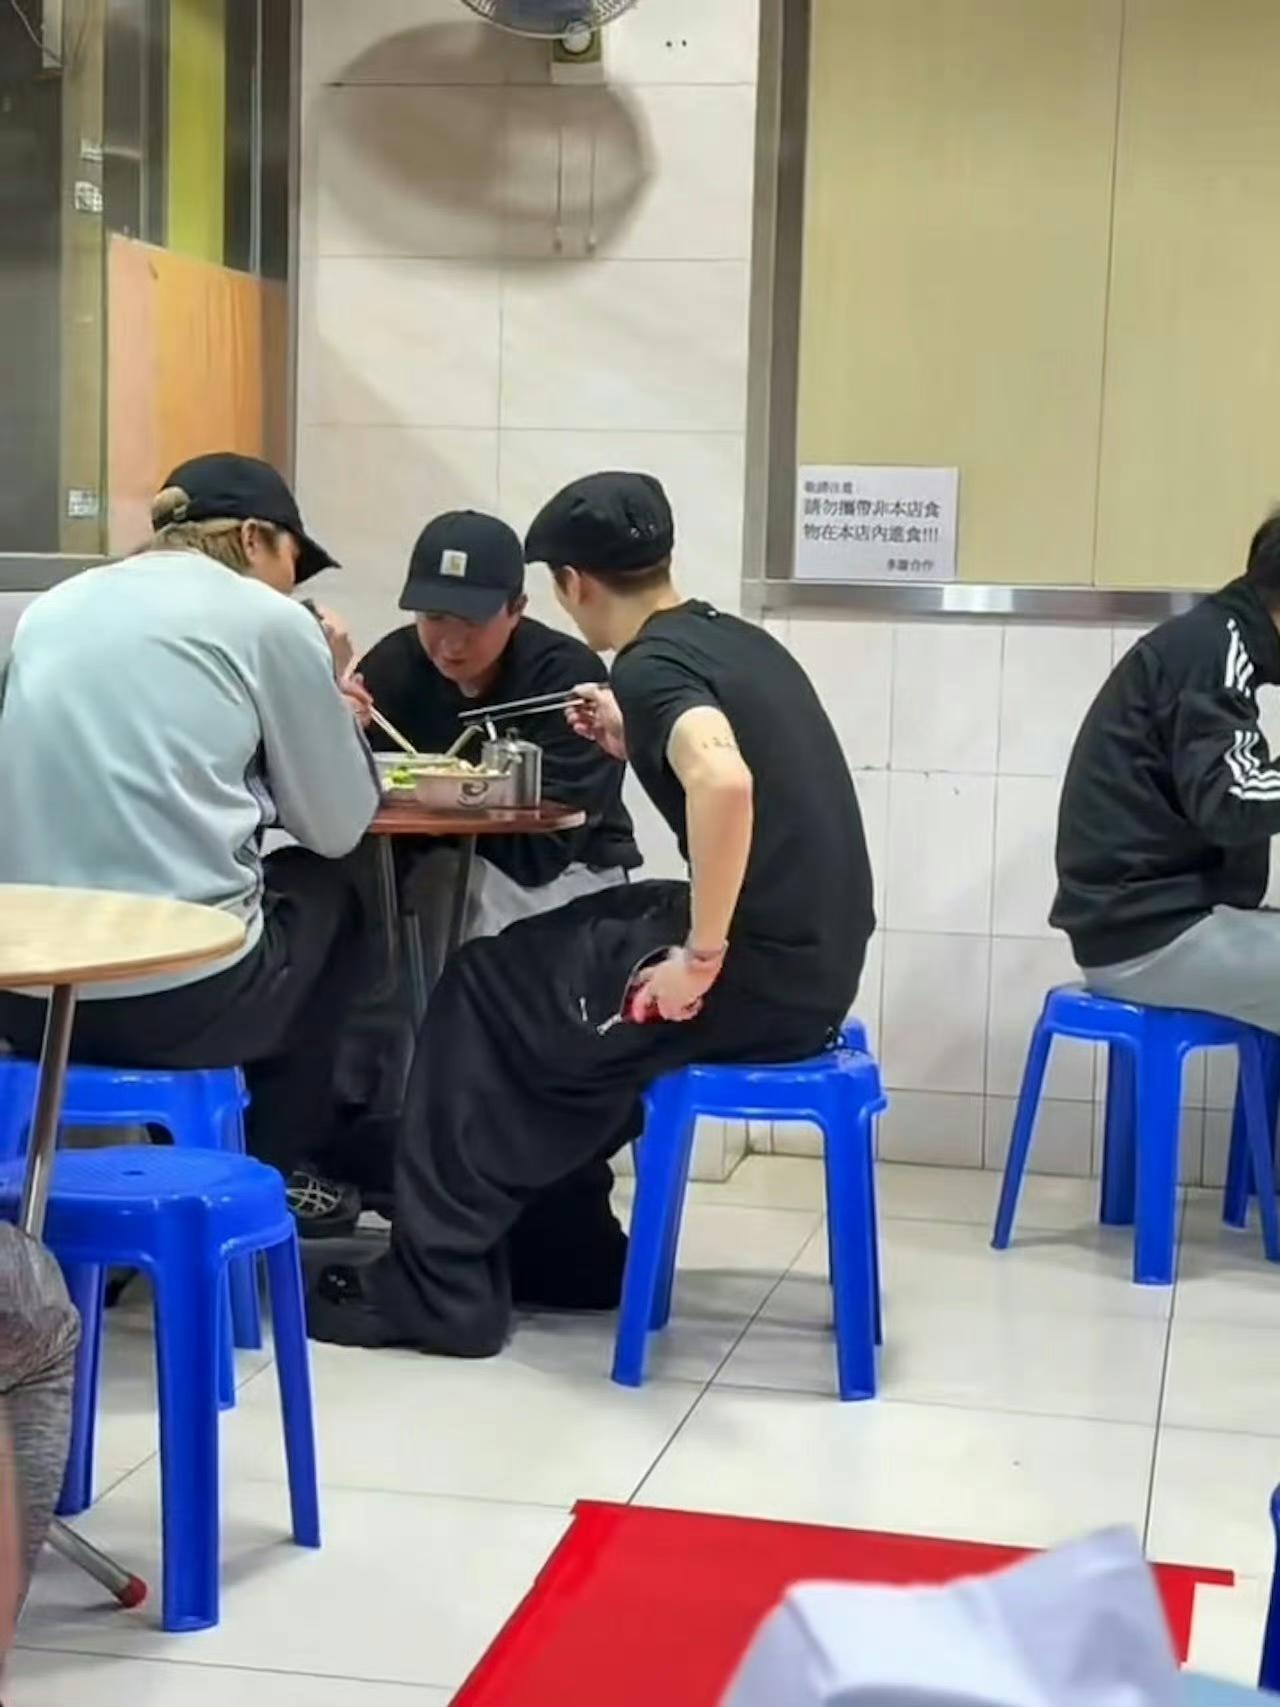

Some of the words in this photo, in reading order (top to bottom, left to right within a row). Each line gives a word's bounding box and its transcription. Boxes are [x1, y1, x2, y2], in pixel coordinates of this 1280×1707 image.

[804, 499, 939, 518] 請勿攜帶非本店食
